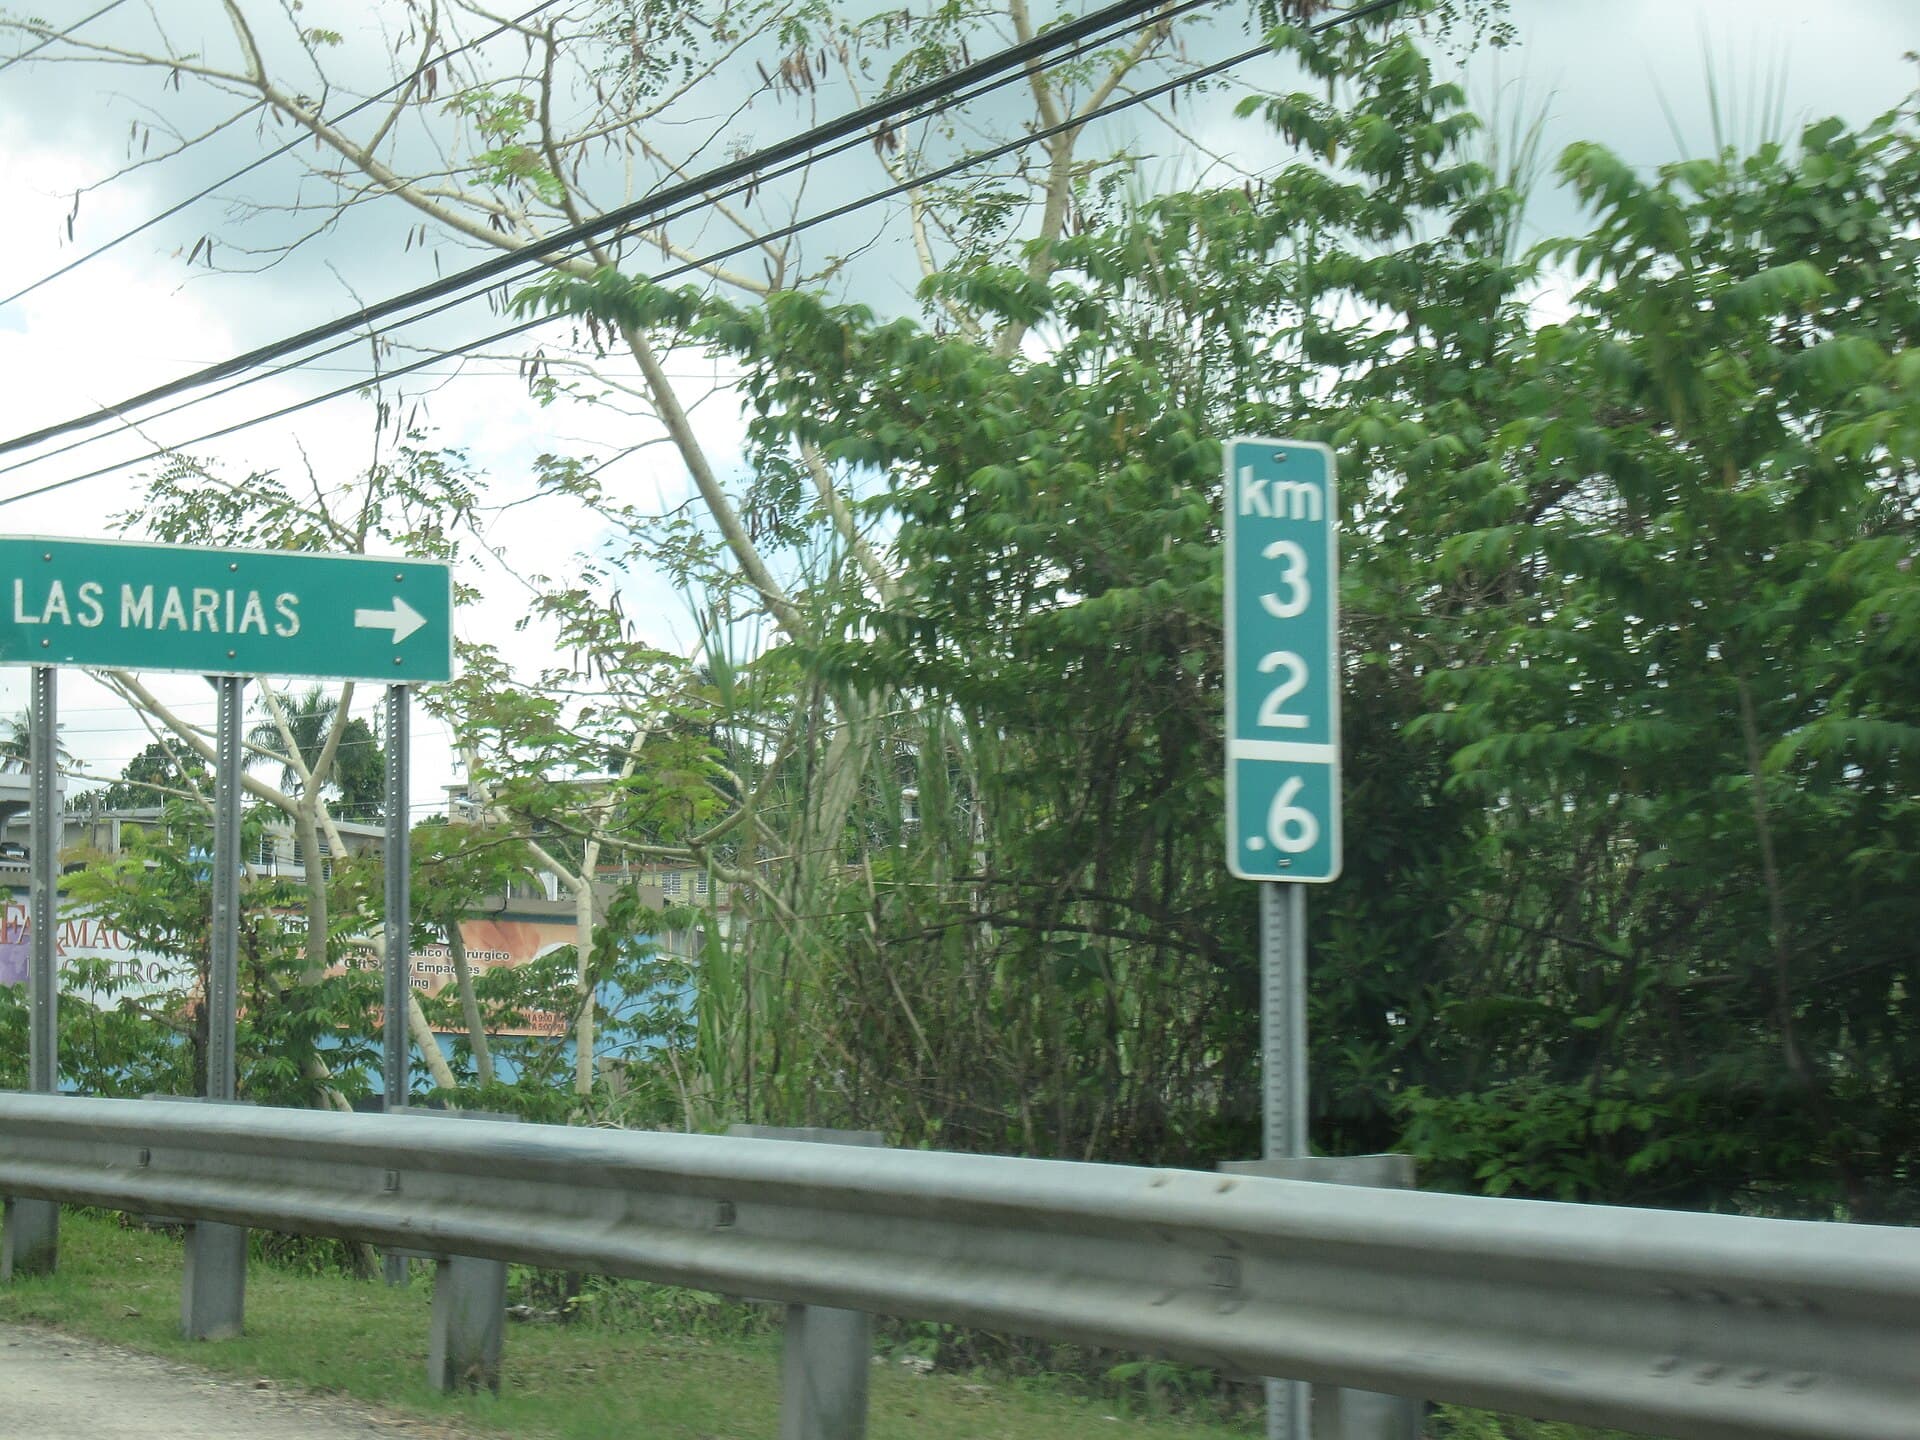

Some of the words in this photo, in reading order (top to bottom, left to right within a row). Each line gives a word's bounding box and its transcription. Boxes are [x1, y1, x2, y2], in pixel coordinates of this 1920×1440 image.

[1238, 465, 1323, 522] km
[13, 578, 104, 628] LAS
[120, 583, 301, 638] MARIAS
[1258, 539, 1312, 619] 3
[1256, 650, 1310, 730] 2
[1245, 775, 1320, 854] .6
